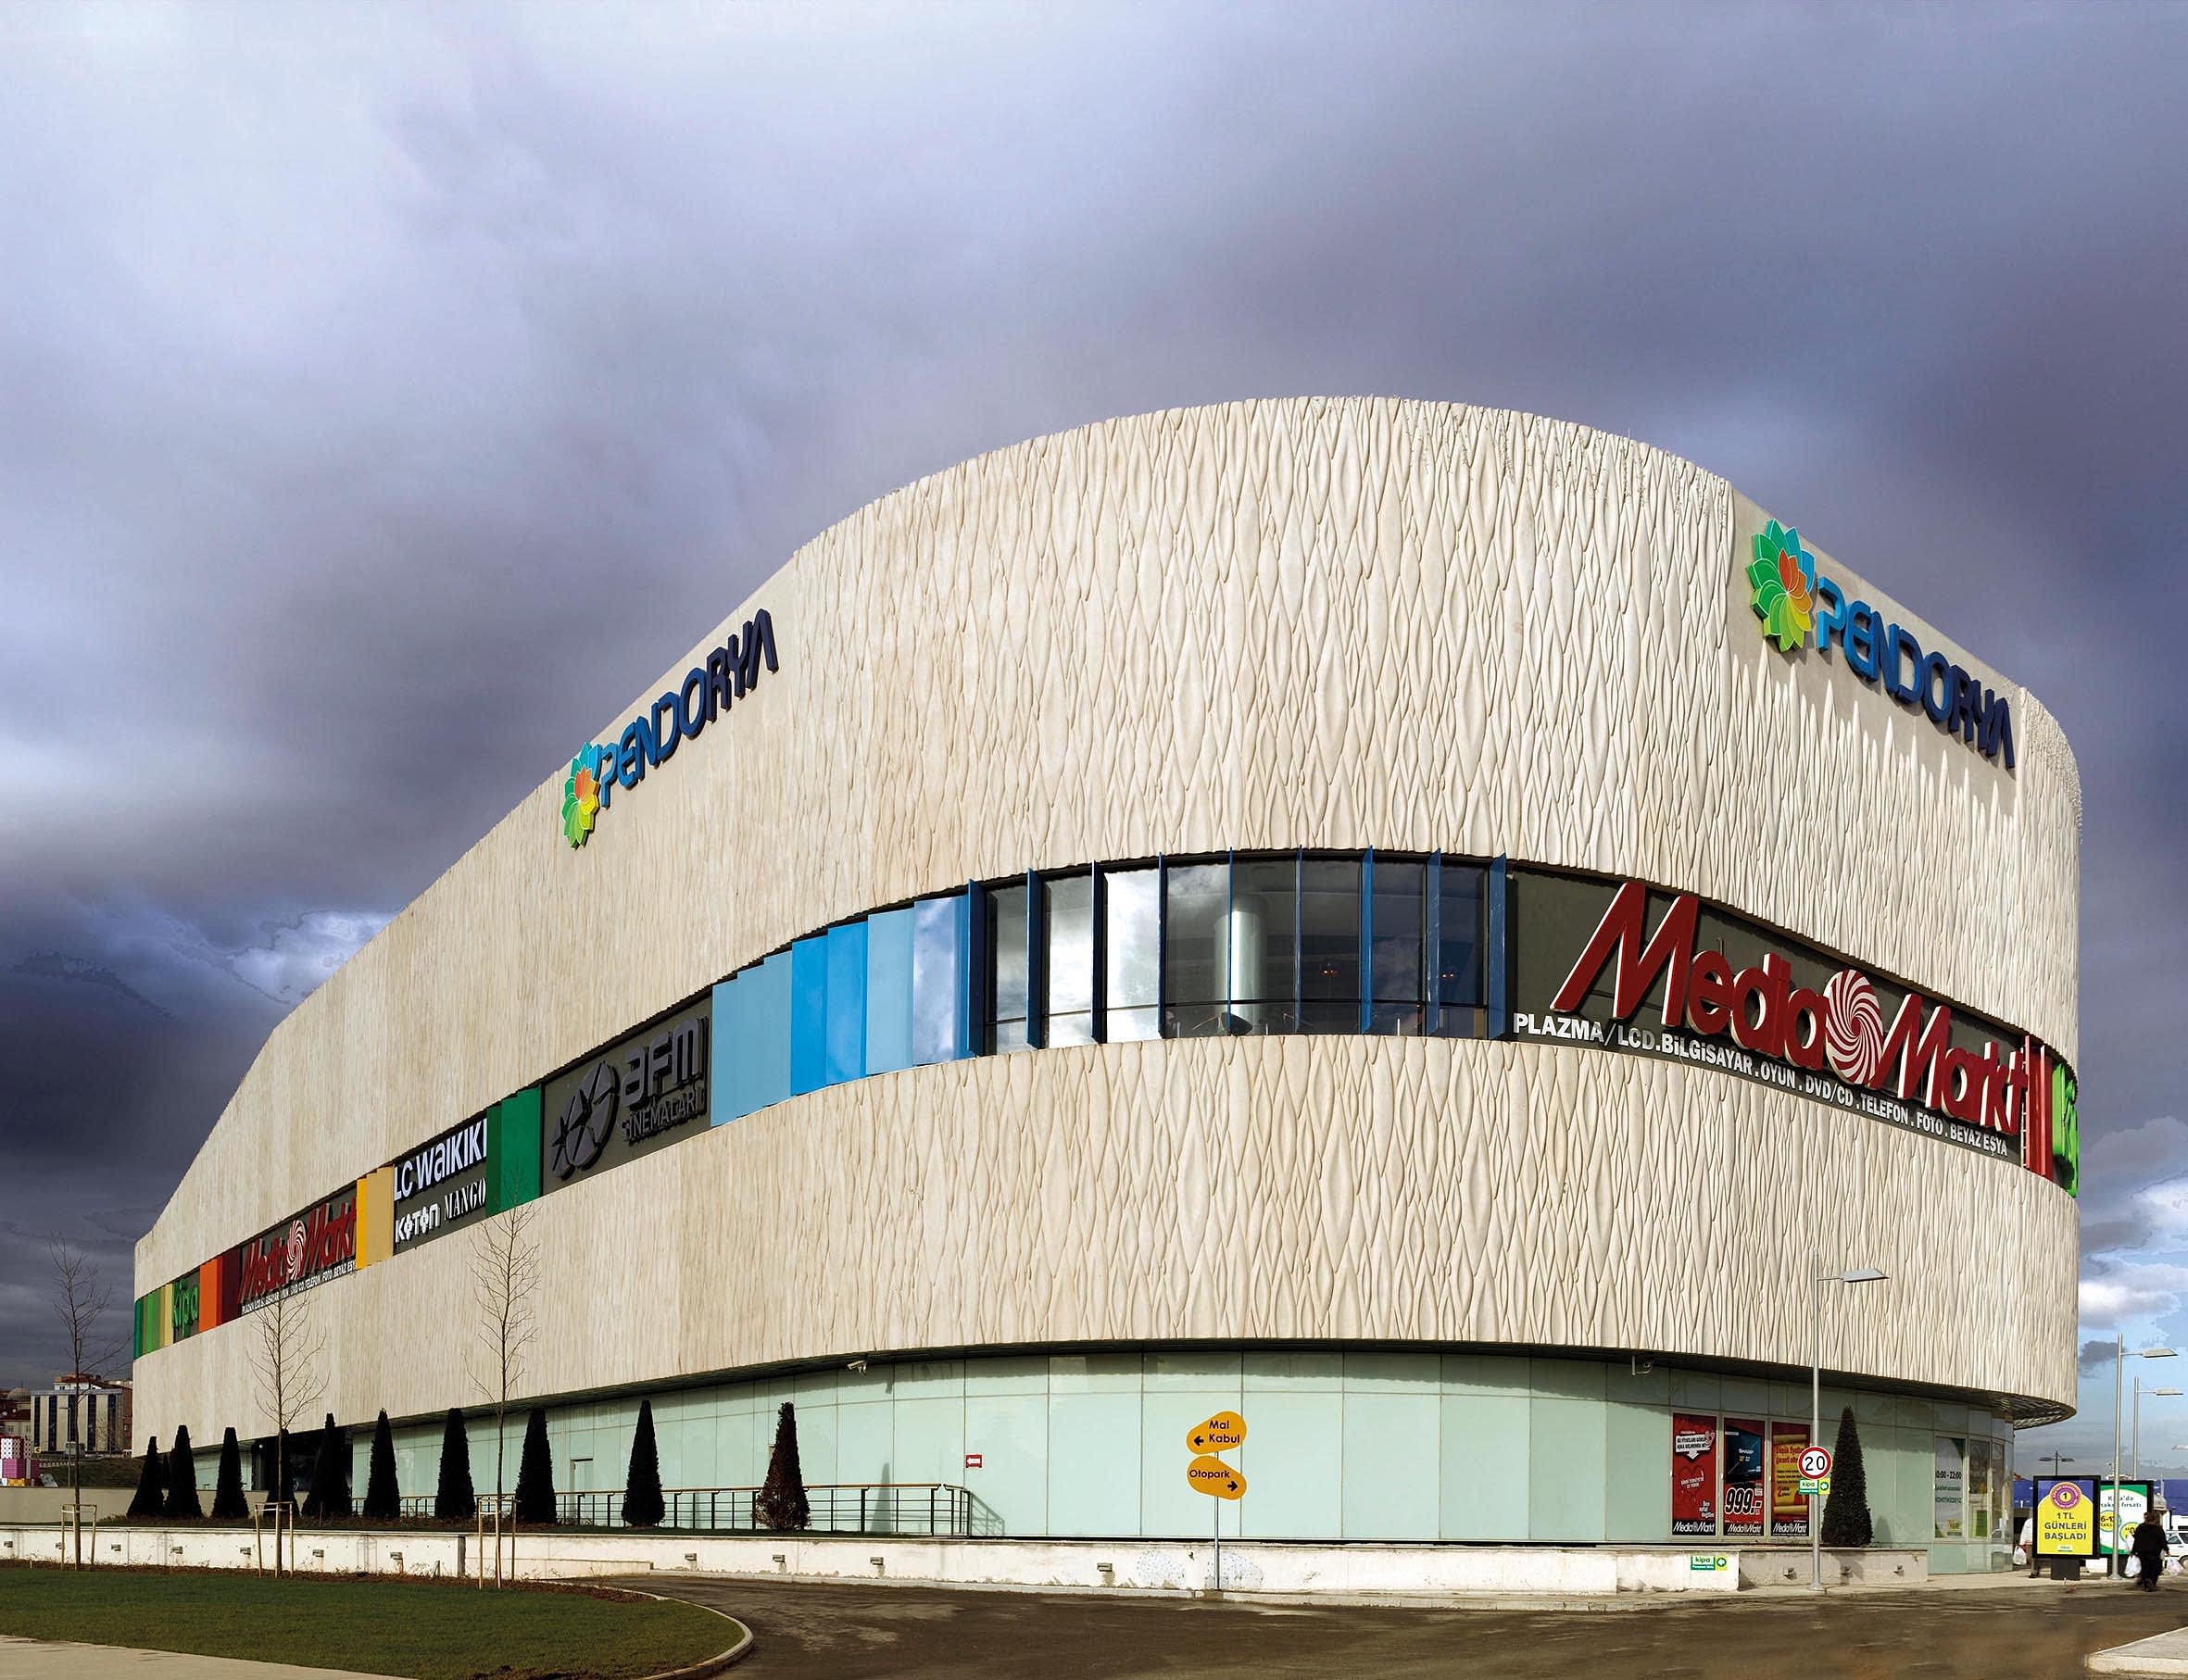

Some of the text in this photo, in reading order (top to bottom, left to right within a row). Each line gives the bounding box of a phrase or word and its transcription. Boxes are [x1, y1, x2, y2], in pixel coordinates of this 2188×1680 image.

[1817, 576, 2016, 769] PENDORYA
[599, 608, 780, 809] PENDORYA
[1760, 1064, 1796, 1090] OYUN
[1917, 1110, 1943, 1135] FOTO
[1950, 1123, 1981, 1147] BEYAZ
[1982, 1134, 2008, 1157] EŞYA
[394, 1160, 413, 1201] LC
[445, 1177, 486, 1221] MANGO
[1209, 1420, 1229, 1430] Mal
[1209, 1433, 1240, 1443] Kabul
[1804, 1456, 1826, 1471] 20
[1189, 1469, 1230, 1479] Otopark
[2044, 1521, 2086, 1530] GÜNLERİ
[2044, 1533, 2086, 1541] BAŞLADI
